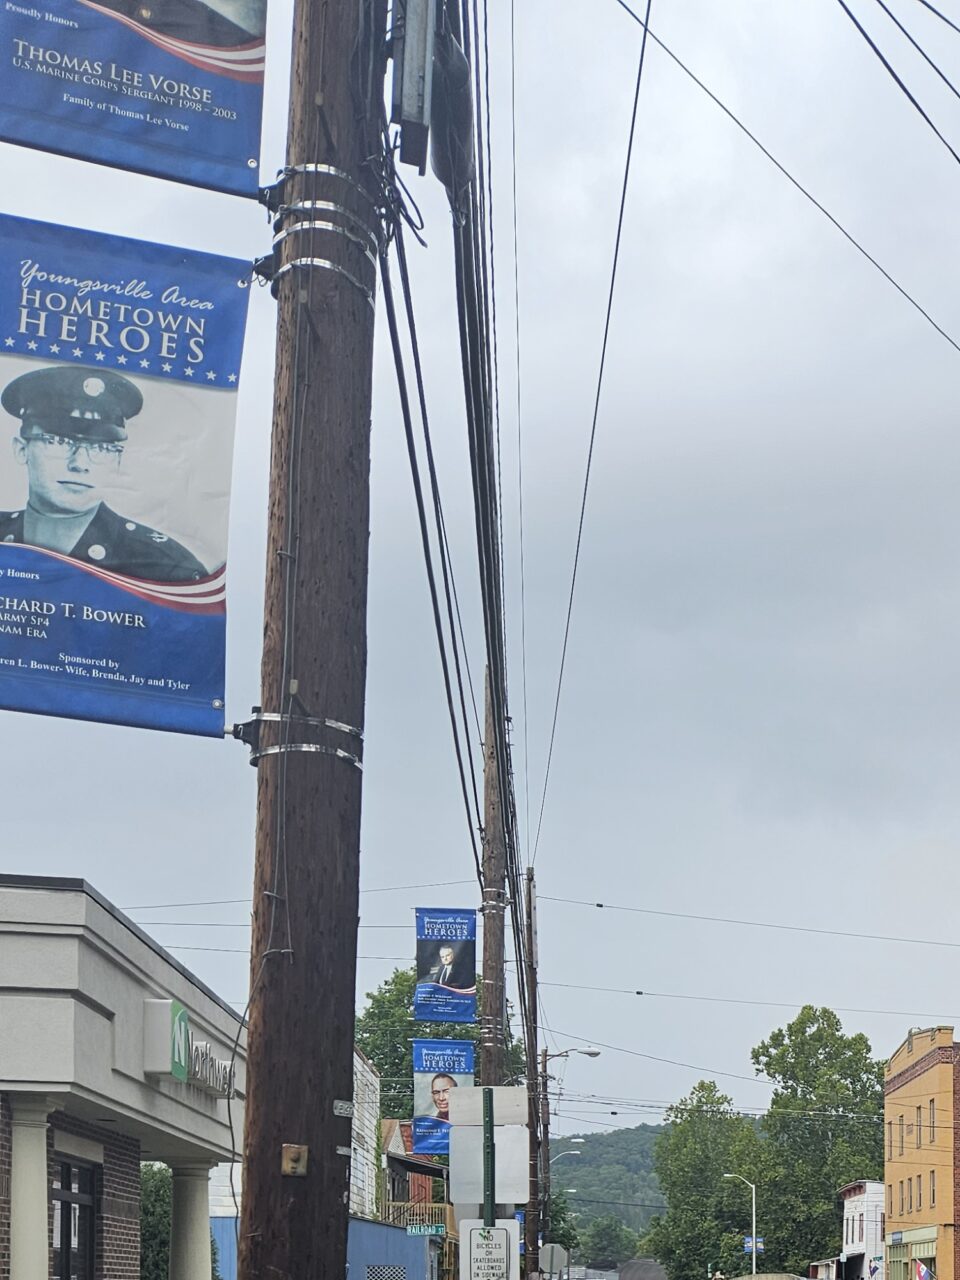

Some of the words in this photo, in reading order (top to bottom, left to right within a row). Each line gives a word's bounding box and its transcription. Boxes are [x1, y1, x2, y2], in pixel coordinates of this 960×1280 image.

[5, 2, 42, 20] Proudly
[44, 12, 79, 29] Honors
[13, 38, 103, 75] THOMAS
[110, 63, 143, 87] LEE
[149, 73, 212, 103] VORSE
[12, 57, 33, 71] U.S.
[36, 64, 80, 82] MARINE
[82, 75, 119, 92] CORPS
[121, 84, 177, 106] SERGEANT
[179, 99, 202, 112] 1998
[212, 106, 237, 121] 2003
[62, 93, 96, 109] Family
[96, 102, 108, 112] of
[108, 104, 144, 120] Thomas
[146, 113, 163, 125] Lee
[164, 118, 190, 131] Vorse
[20, 259, 153, 299] Youngsville
[161, 286, 215, 311] Area
[20, 287, 205, 336] HOMETOWN
[17, 307, 205, 364] HEROES
[7, 568, 40, 580] Honors
[61, 602, 77, 618] T.
[82, 606, 146, 628] BOWER
[26, 627, 48, 639] ERA
[18, 658, 28, 668] L.
[65, 665, 90, 678] Wife,
[92, 669, 128, 684] Brenda,
[129, 674, 146, 686] Jay
[147, 678, 165, 688] and
[166, 679, 191, 691] Tyler
[58, 652, 107, 668] Sponsored
[108, 658, 120, 671] by
[425, 928, 468, 936] HEROES
[422, 1060, 466, 1068] HEROES
[407, 1225, 436, 1235] RAILROAD
